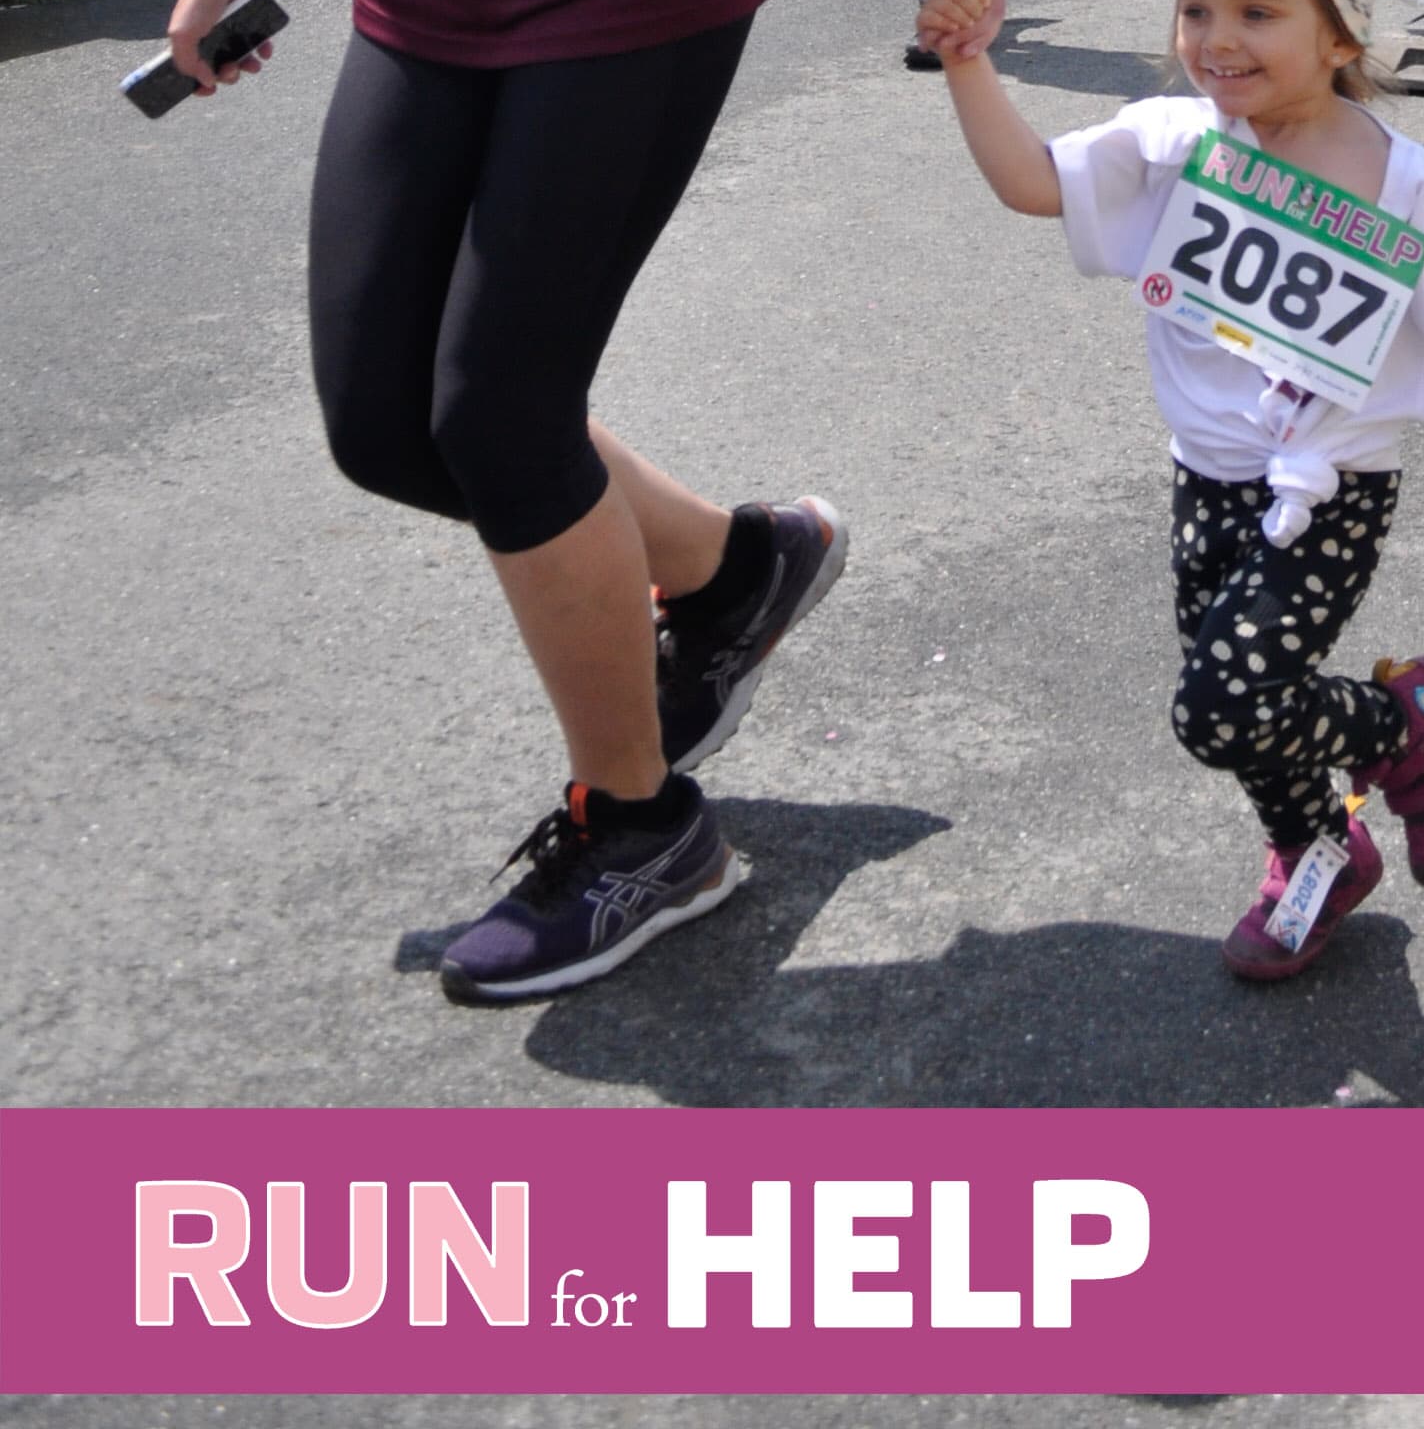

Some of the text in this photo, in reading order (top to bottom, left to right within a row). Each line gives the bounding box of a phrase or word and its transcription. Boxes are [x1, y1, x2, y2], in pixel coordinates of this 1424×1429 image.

[1201, 142, 1297, 211] RUN
[1309, 190, 1424, 268] HELP
[1169, 201, 1389, 347] 2087
[1291, 860, 1322, 913] 2087
